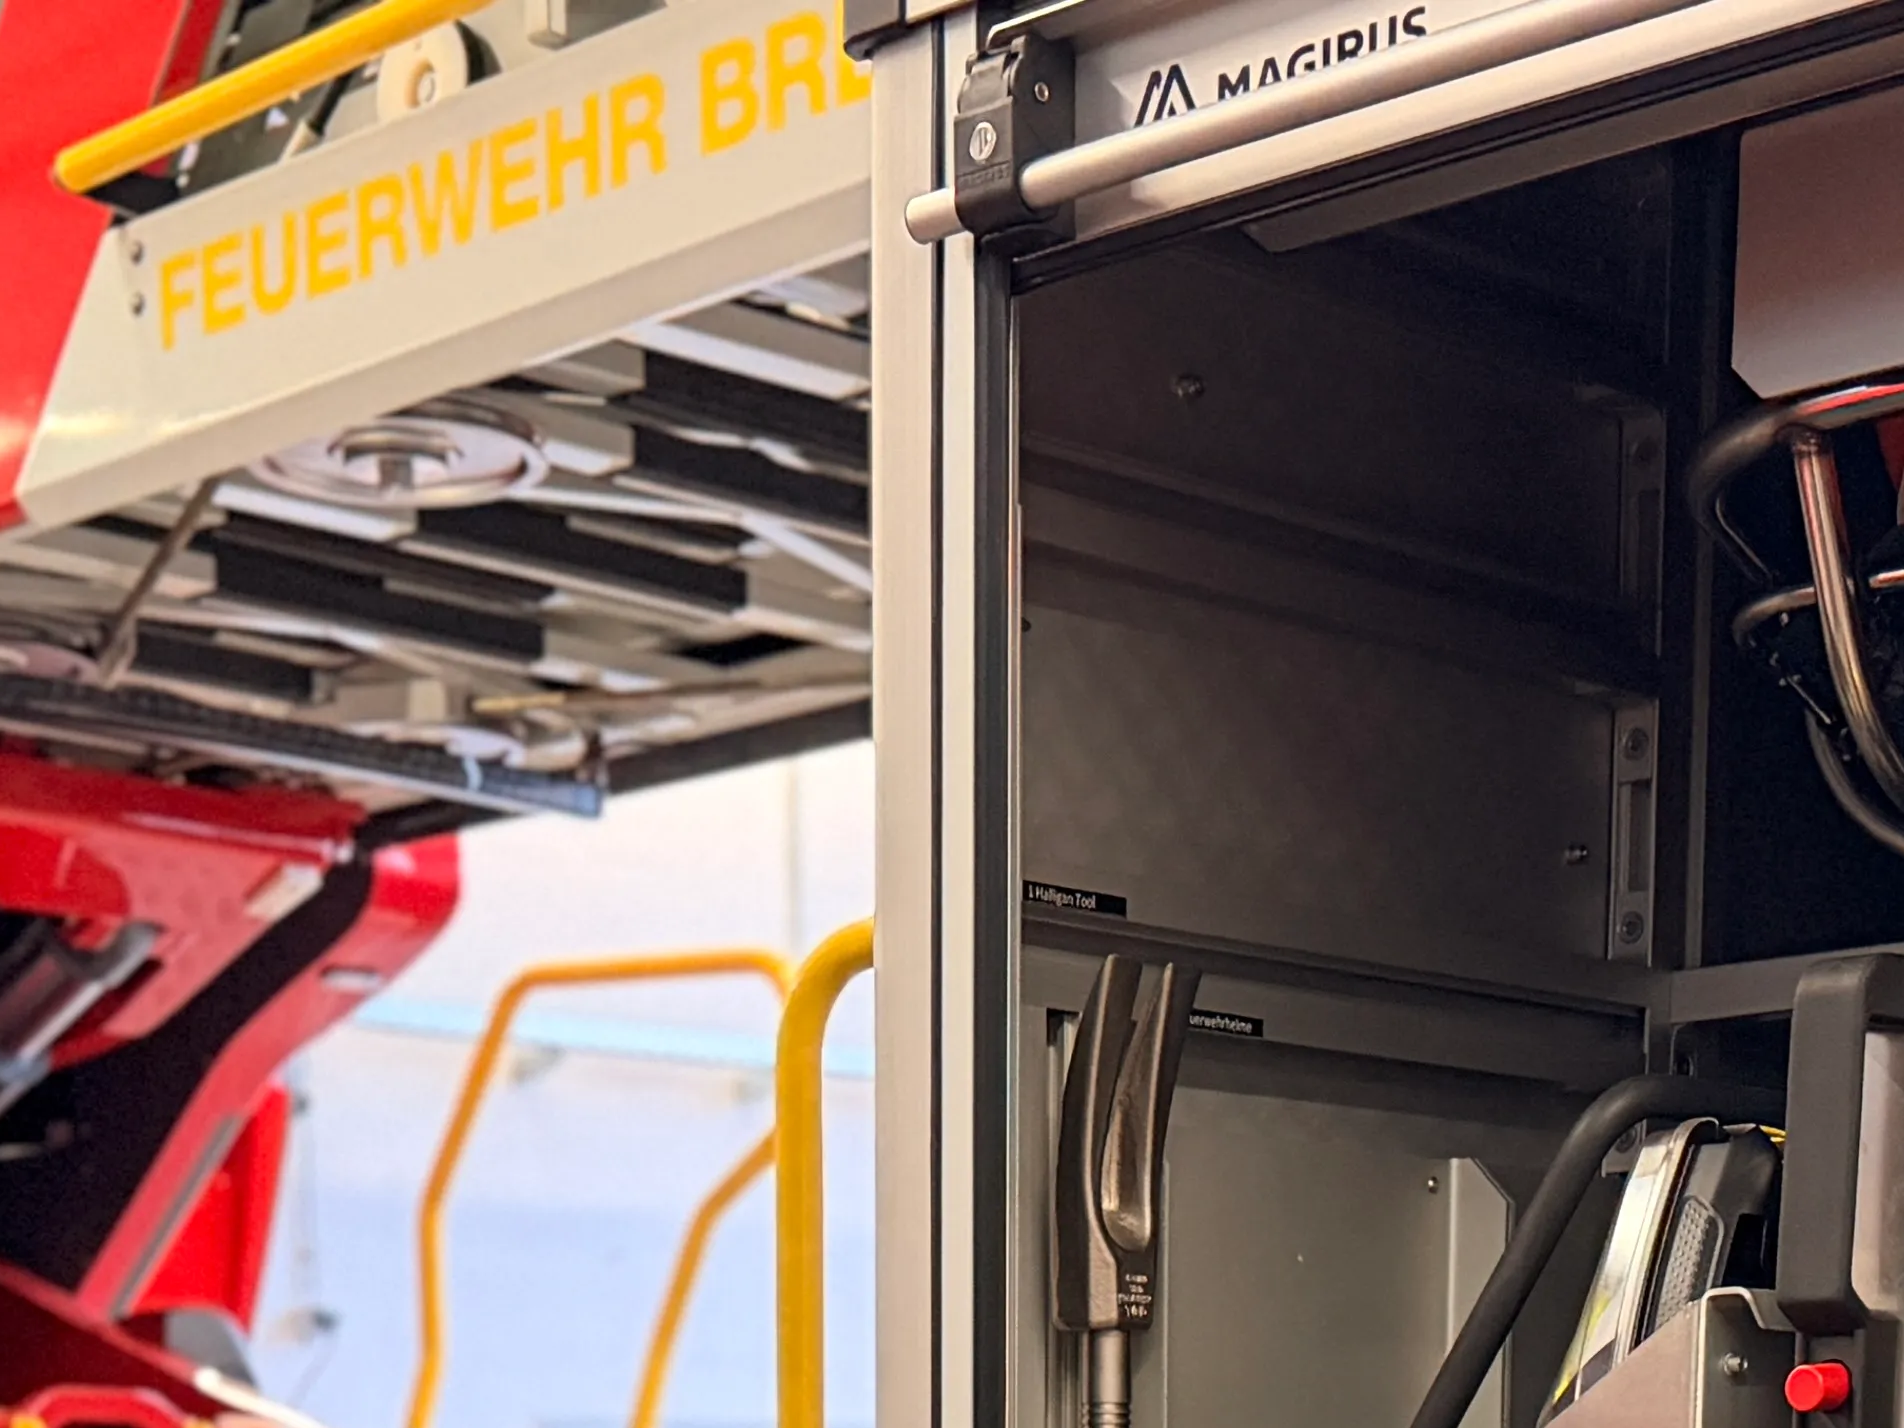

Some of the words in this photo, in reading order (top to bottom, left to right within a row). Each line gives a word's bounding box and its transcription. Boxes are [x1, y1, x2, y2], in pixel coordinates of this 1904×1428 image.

[159, 72, 668, 351] FEUERWEHR
[1035, 886, 1074, 908] Halligan
[1075, 892, 1096, 909] Tool
